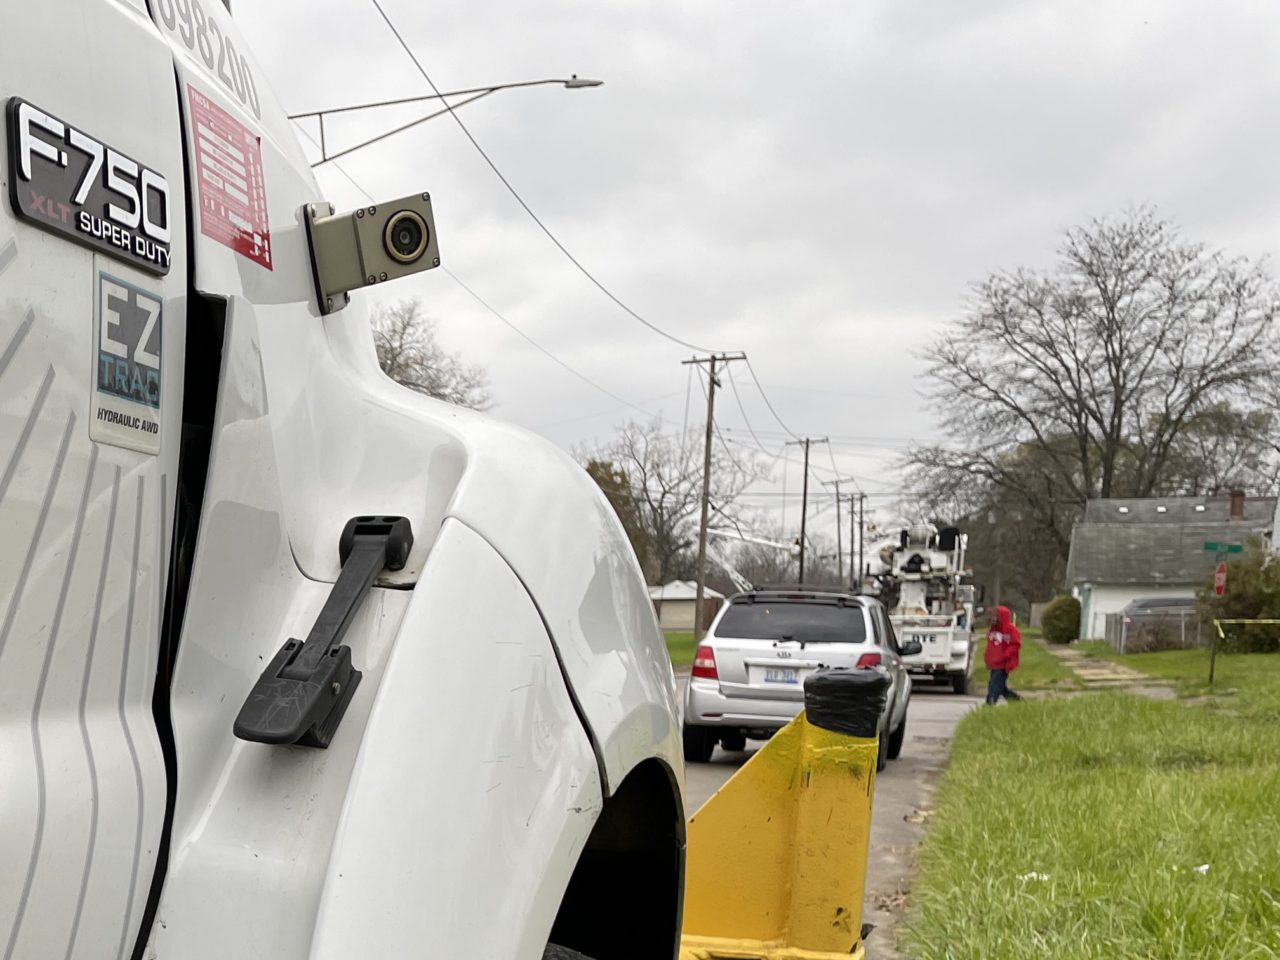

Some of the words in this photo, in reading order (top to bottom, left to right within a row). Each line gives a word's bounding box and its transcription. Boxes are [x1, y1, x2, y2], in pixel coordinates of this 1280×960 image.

[30, 191, 70, 224] XLT
[80, 211, 131, 251] SUPER
[136, 236, 171, 267] DUTY
[100, 278, 161, 370] EZ
[97, 407, 141, 430] HYDRAULIC
[141, 420, 160, 435] AWD
